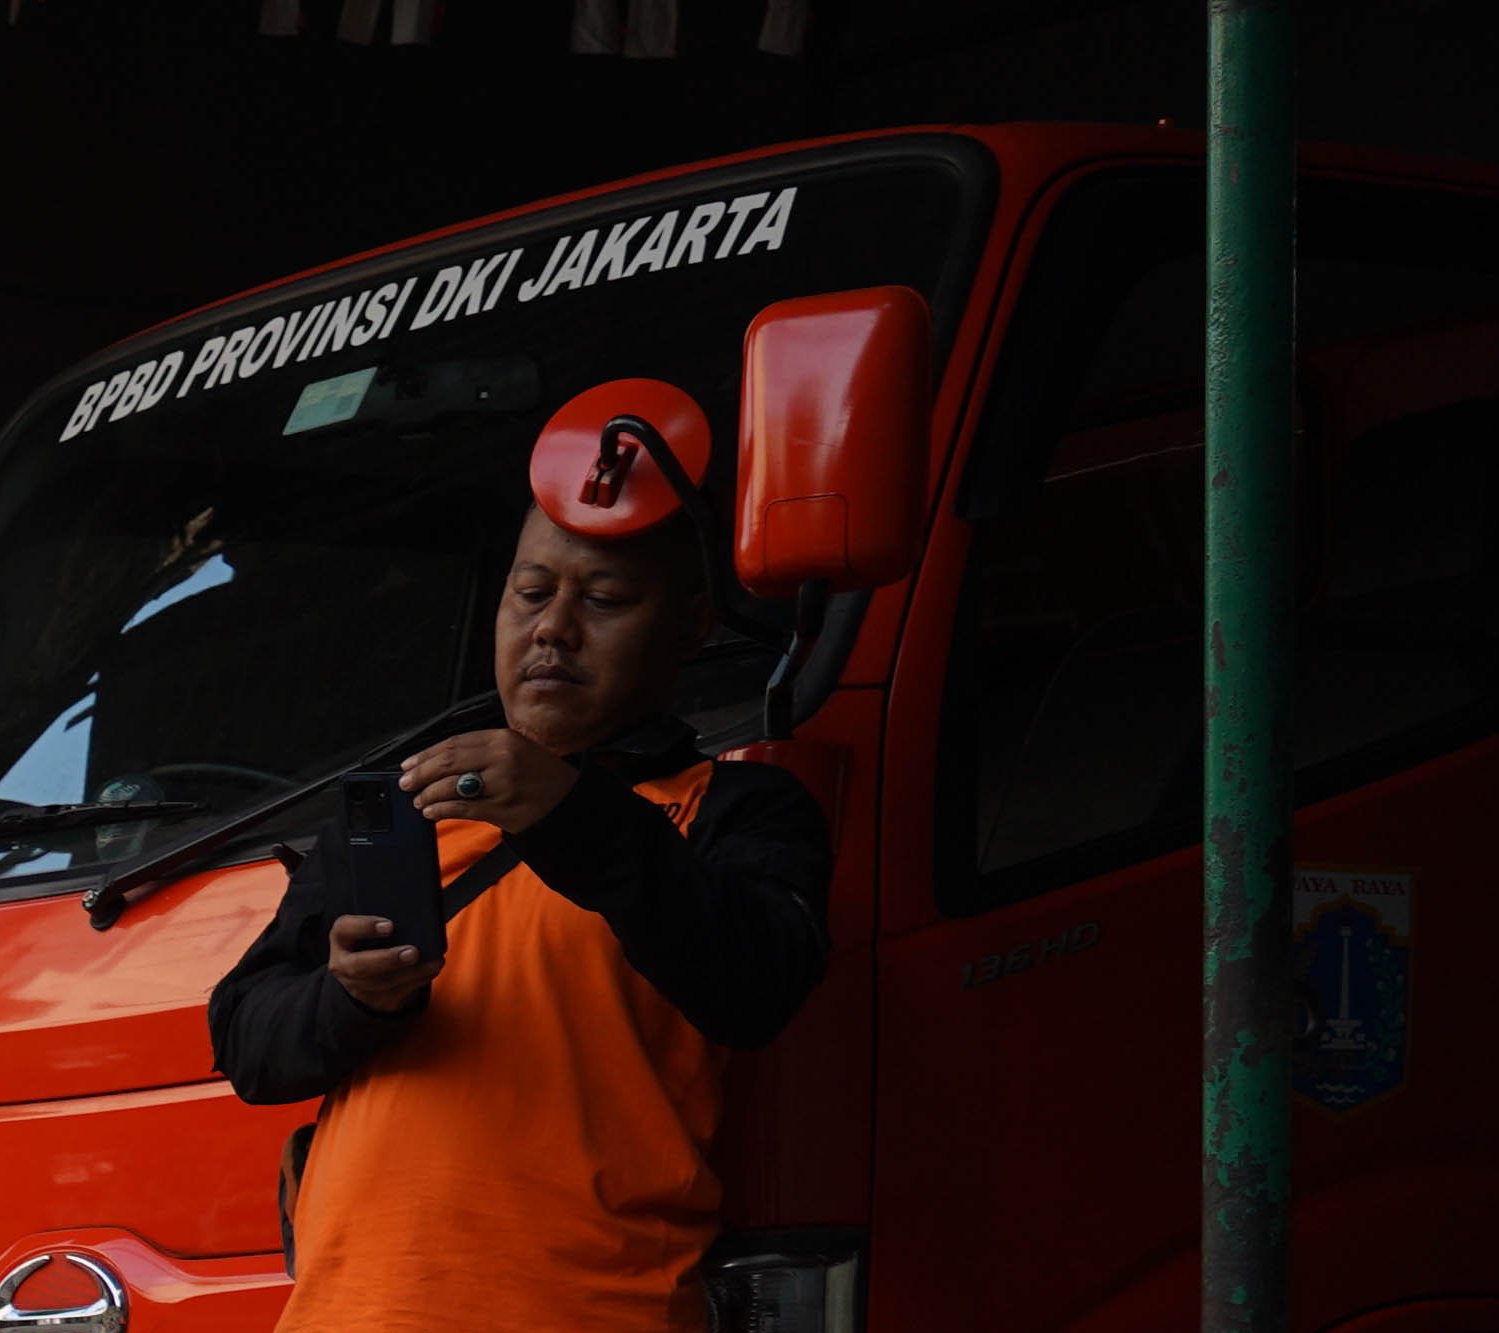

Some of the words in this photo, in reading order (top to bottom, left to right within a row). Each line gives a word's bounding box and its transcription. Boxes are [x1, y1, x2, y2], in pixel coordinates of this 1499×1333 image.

[59, 362, 183, 443] BPBD
[176, 278, 419, 399] PROVINSI
[409, 250, 520, 331] DKI
[518, 186, 798, 302] JAKARTA
